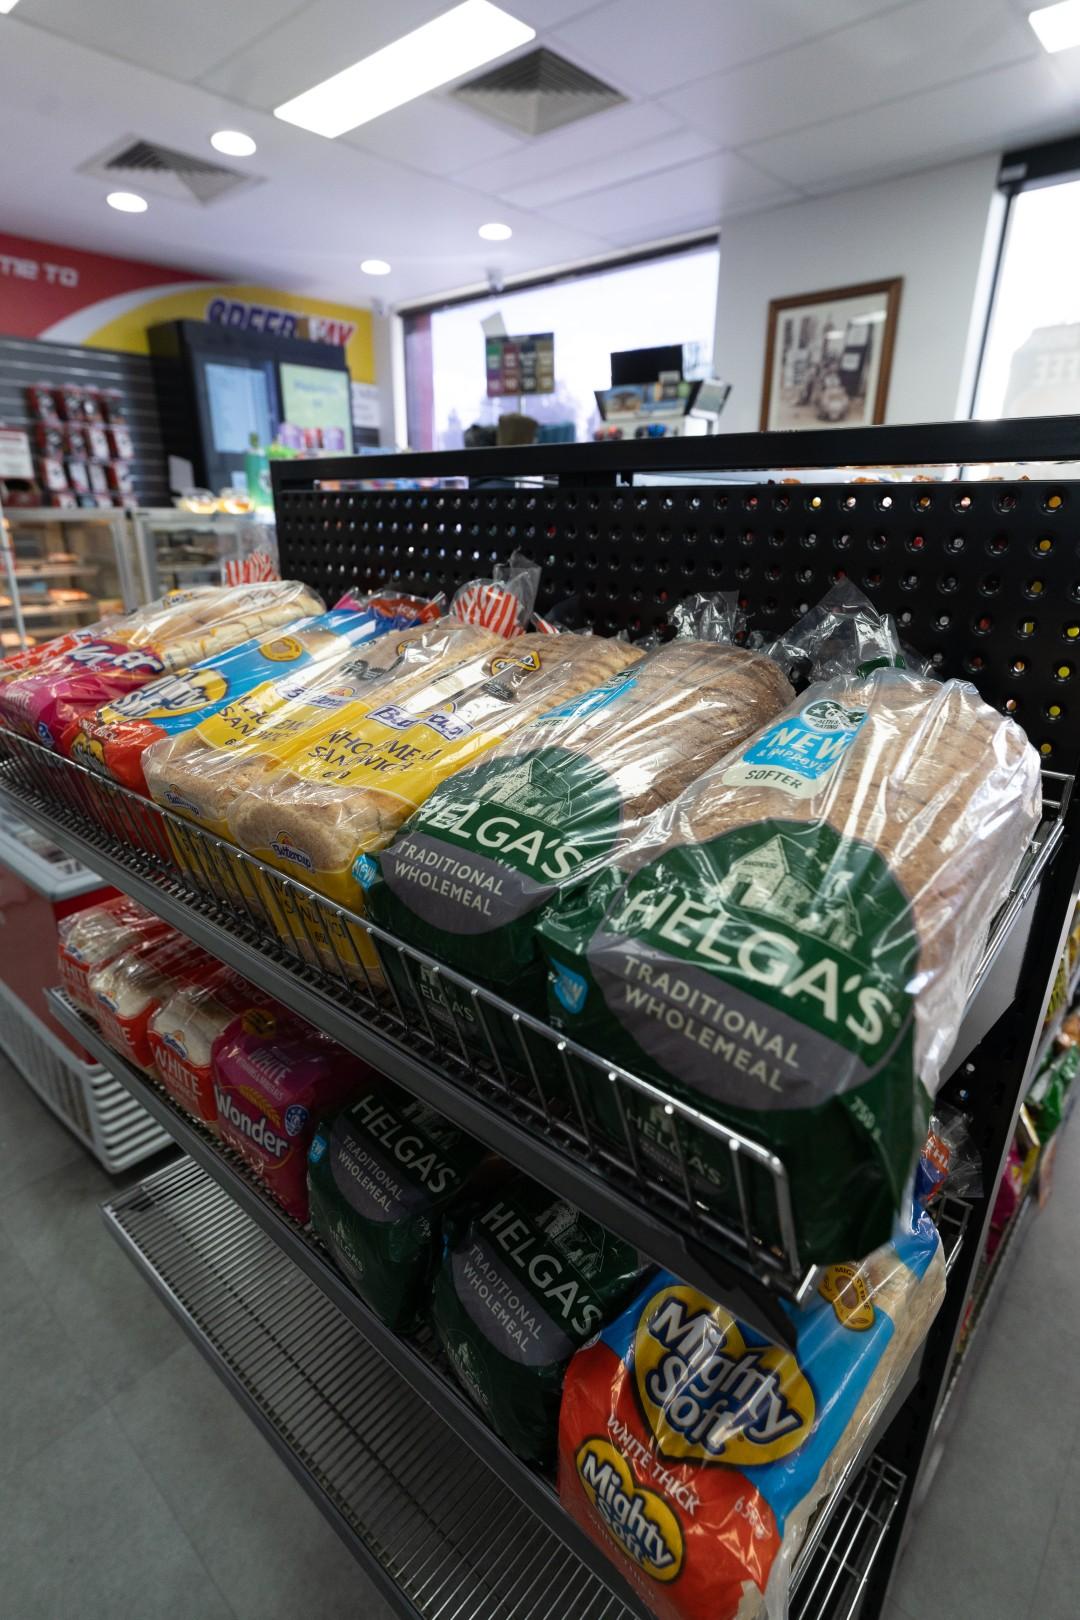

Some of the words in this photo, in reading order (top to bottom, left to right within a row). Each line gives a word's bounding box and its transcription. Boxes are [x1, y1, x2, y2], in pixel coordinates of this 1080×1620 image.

[744, 769, 802, 789] SOFTER
[767, 727, 850, 760] NEW
[768, 748, 834, 773] IMPROVE
[393, 859, 493, 917] WHOLEMEAL
[398, 840, 504, 897] TRADITIONAL
[621, 888, 894, 1047] HELGA'S
[624, 954, 801, 1070] TRADITIONAL
[624, 984, 785, 1094] WHOLEMEAL
[213, 1083, 289, 1158] Wonder
[342, 1135, 405, 1201] TRADITIONAL
[351, 1093, 457, 1194] HELGA'S
[337, 1150, 394, 1213] WHOLEMEAL
[462, 1261, 530, 1353] WHOLEMEAL
[468, 1243, 543, 1340] TRADITIONAL
[480, 1201, 603, 1337] HELGA'S
[648, 1354, 737, 1450] Soft
[649, 1298, 802, 1441] Mighty
[580, 1452, 676, 1569] Mighty
[607, 1415, 653, 1469] WHITE
[652, 1462, 701, 1516] THICK
